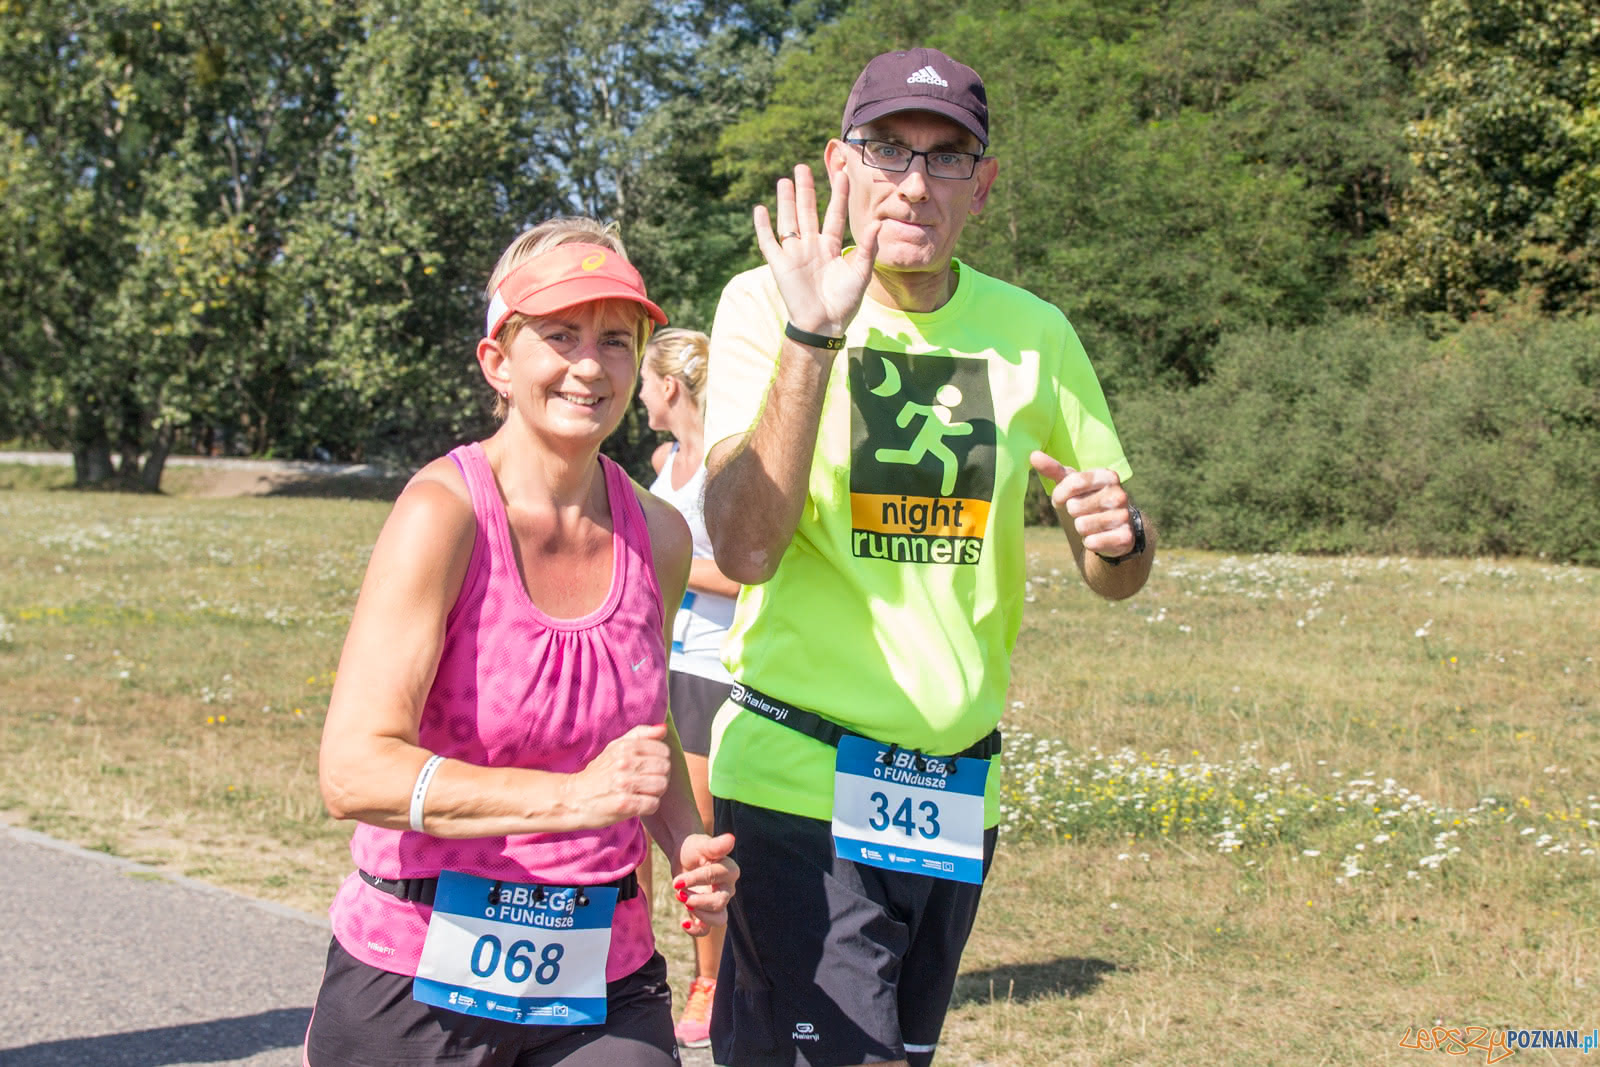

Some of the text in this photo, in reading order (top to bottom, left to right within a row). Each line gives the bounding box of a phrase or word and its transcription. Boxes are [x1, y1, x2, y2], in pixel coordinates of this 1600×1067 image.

[907, 76, 948, 87] adidas
[882, 496, 964, 533] night
[853, 531, 981, 563] runners
[743, 691, 789, 720] Kalenji
[873, 767, 946, 789] o FUNdusze
[869, 791, 941, 840] 343
[485, 905, 574, 928] o FUNdusze
[470, 934, 565, 985] 068
